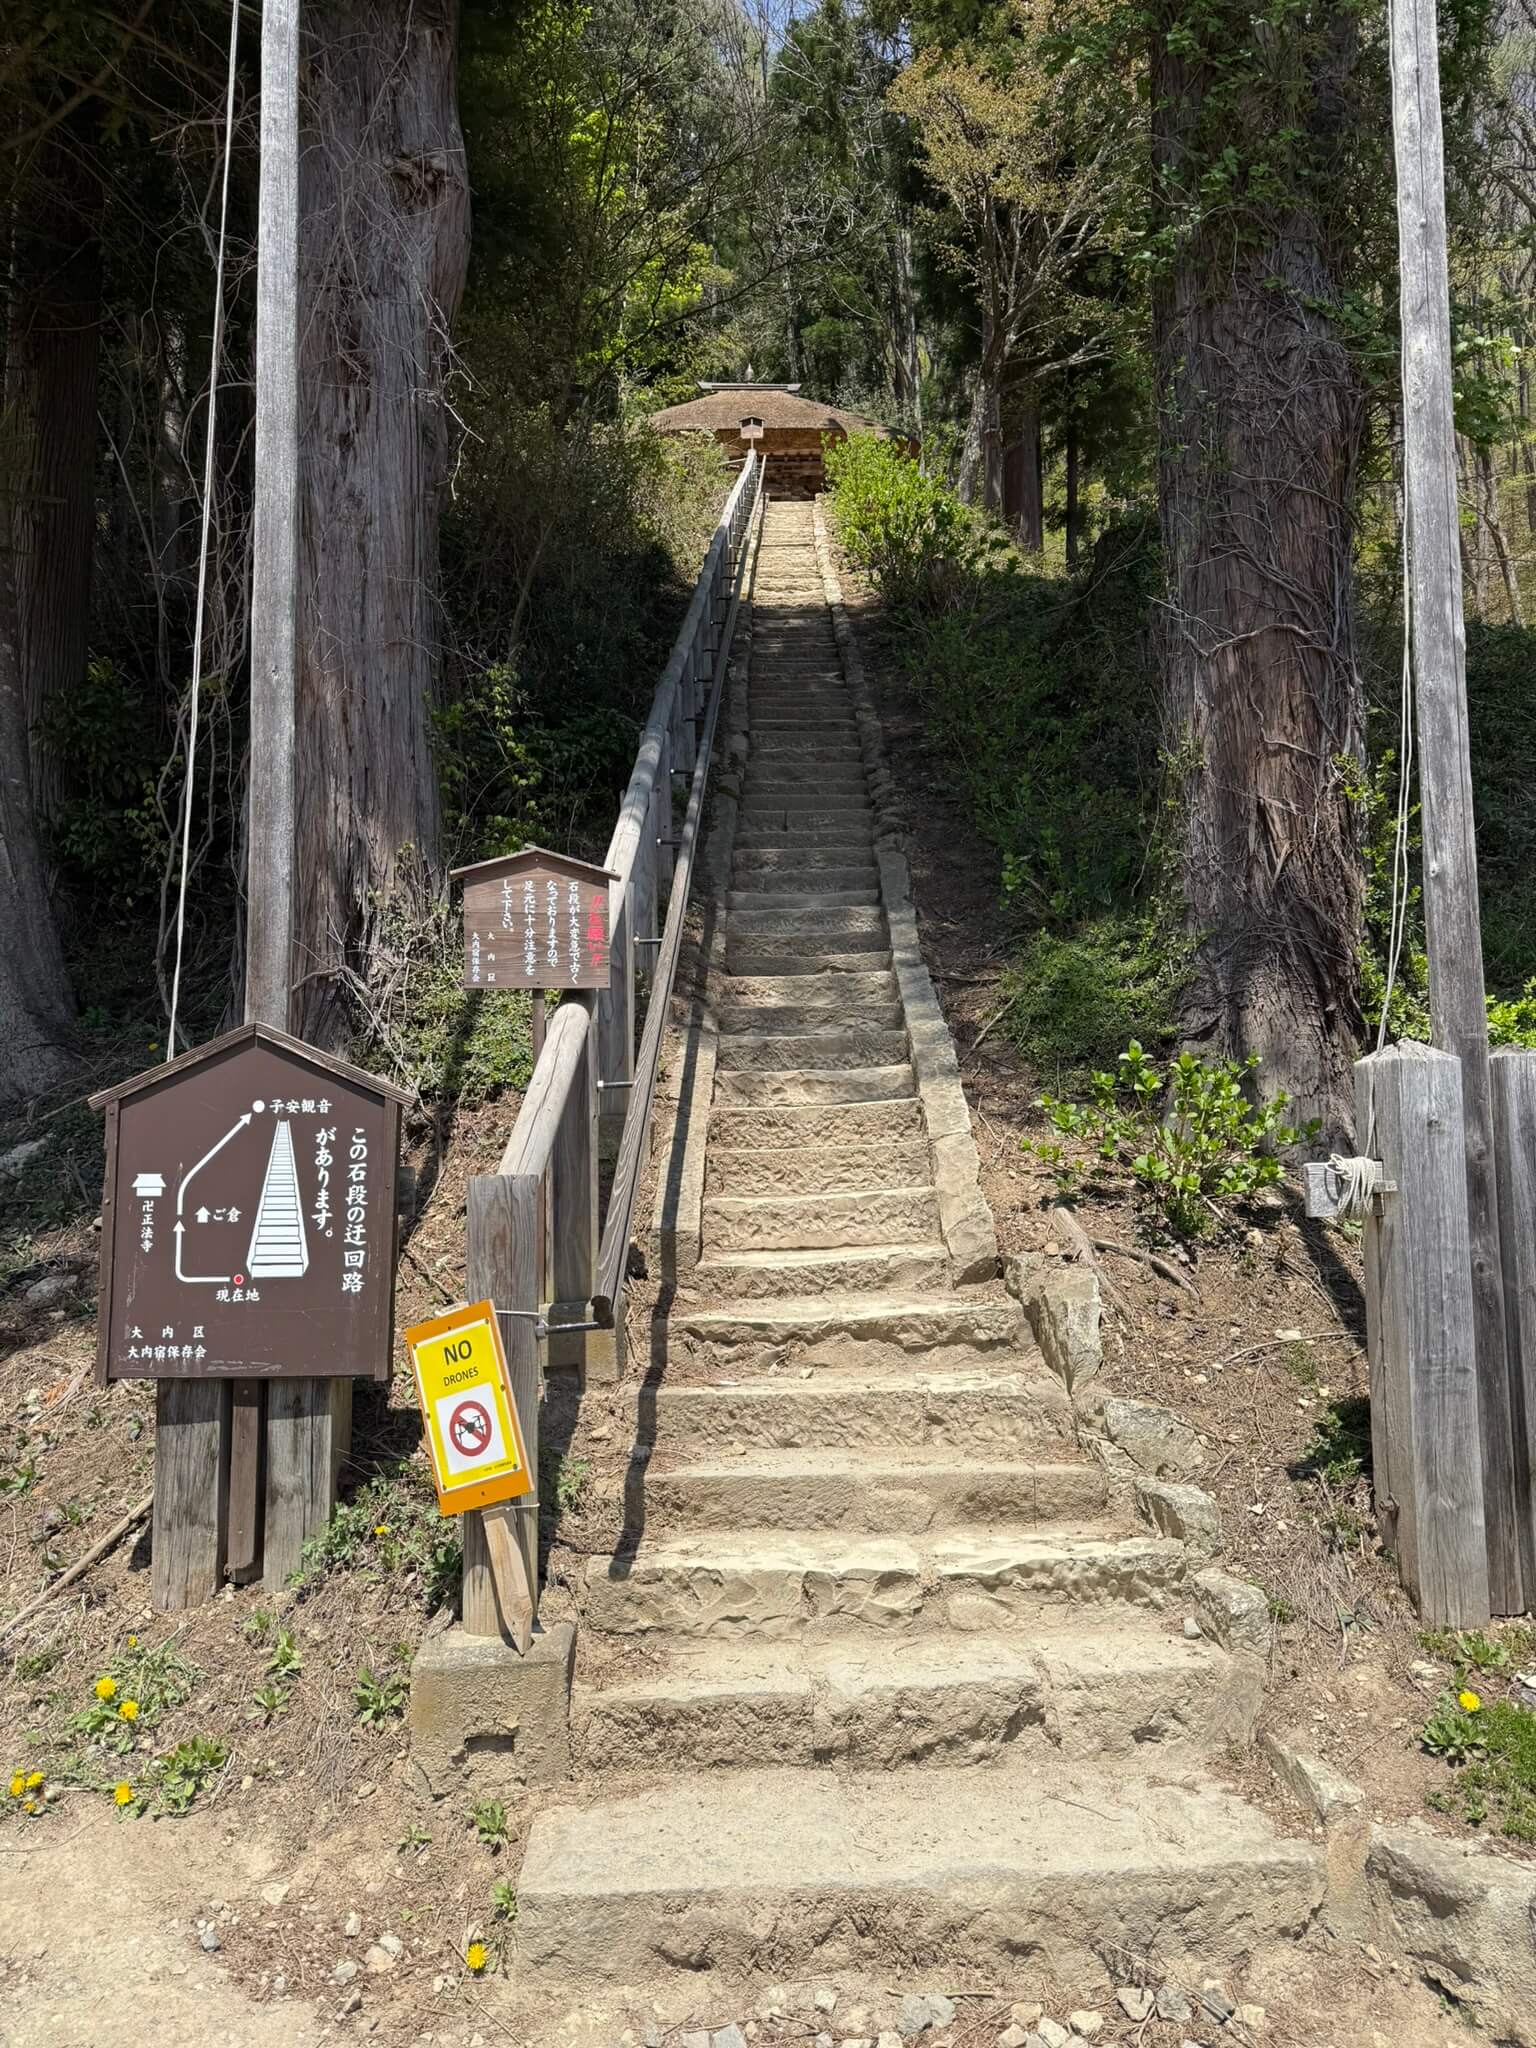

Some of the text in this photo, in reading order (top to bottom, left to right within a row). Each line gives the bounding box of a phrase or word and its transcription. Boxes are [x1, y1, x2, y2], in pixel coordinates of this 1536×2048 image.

[523, 880, 536, 976] 足元に十分注意を
[546, 880, 559, 968] なっておりますので
[269, 1098, 333, 1115] 子安観音
[311, 1126, 337, 1238] があります。
[212, 1206, 242, 1223] ご倉
[341, 1127, 369, 1292] この石段の迂回路
[215, 1288, 261, 1302] 現在地
[127, 1345, 208, 1359] 大内宿保存会
[443, 1339, 473, 1366] NO
[443, 1366, 480, 1387] DRONES
